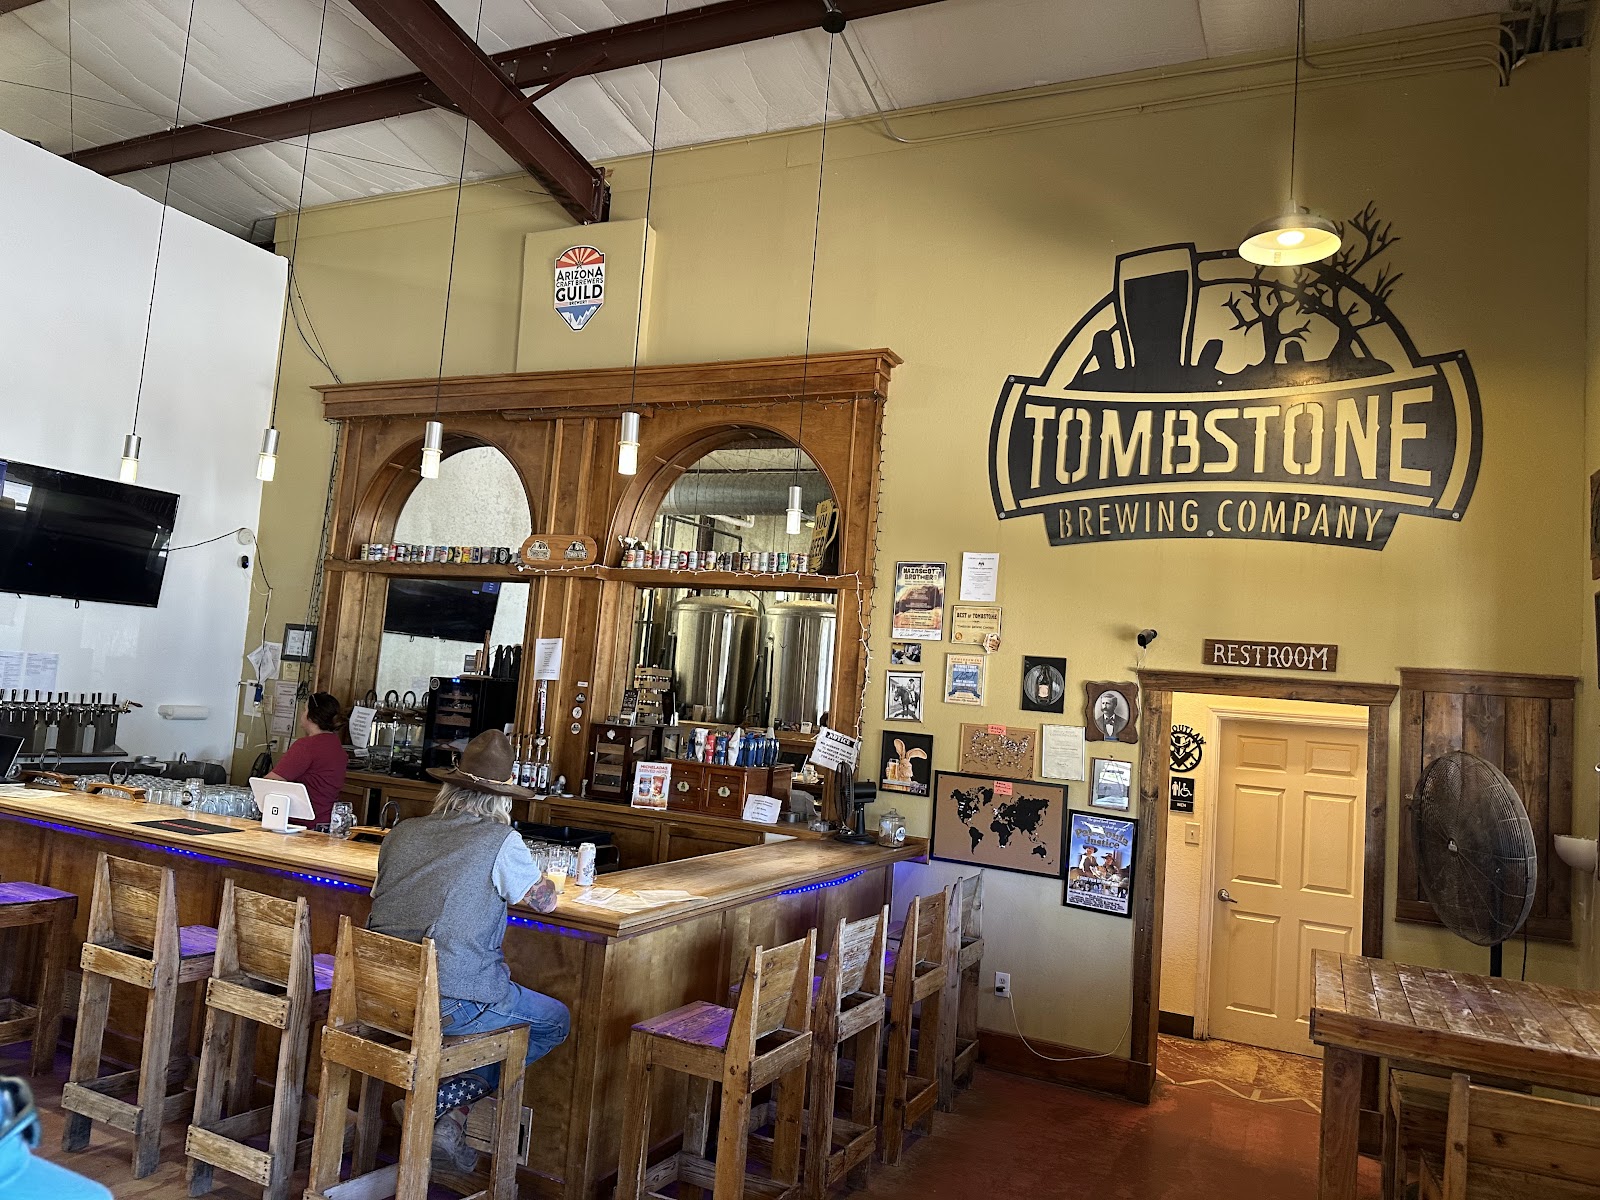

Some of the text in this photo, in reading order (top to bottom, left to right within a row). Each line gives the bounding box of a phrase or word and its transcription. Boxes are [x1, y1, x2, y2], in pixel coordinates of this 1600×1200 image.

[556, 266, 604, 281] ARIZONA
[556, 284, 603, 302] GUILD
[1024, 385, 1433, 488] TOMBSTONE
[1059, 499, 1385, 542] BREWING COMPANY
[1213, 643, 1329, 671] RESTROOM
